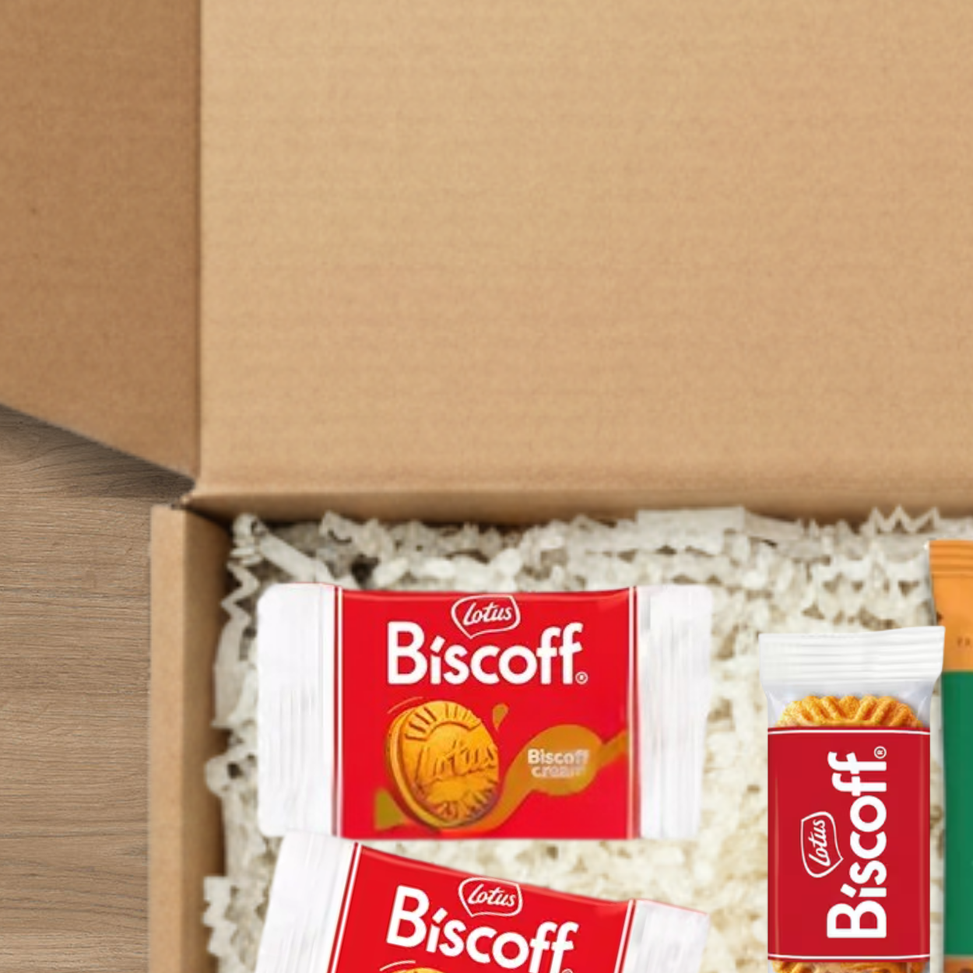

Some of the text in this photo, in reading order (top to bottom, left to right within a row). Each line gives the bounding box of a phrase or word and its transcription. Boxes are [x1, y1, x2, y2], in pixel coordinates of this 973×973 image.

[464, 600, 512, 625] Lotus
[387, 621, 583, 685] Biscoff
[809, 818, 831, 868] Lotus
[826, 751, 888, 939] Biscoff
[467, 883, 517, 909] Lotus
